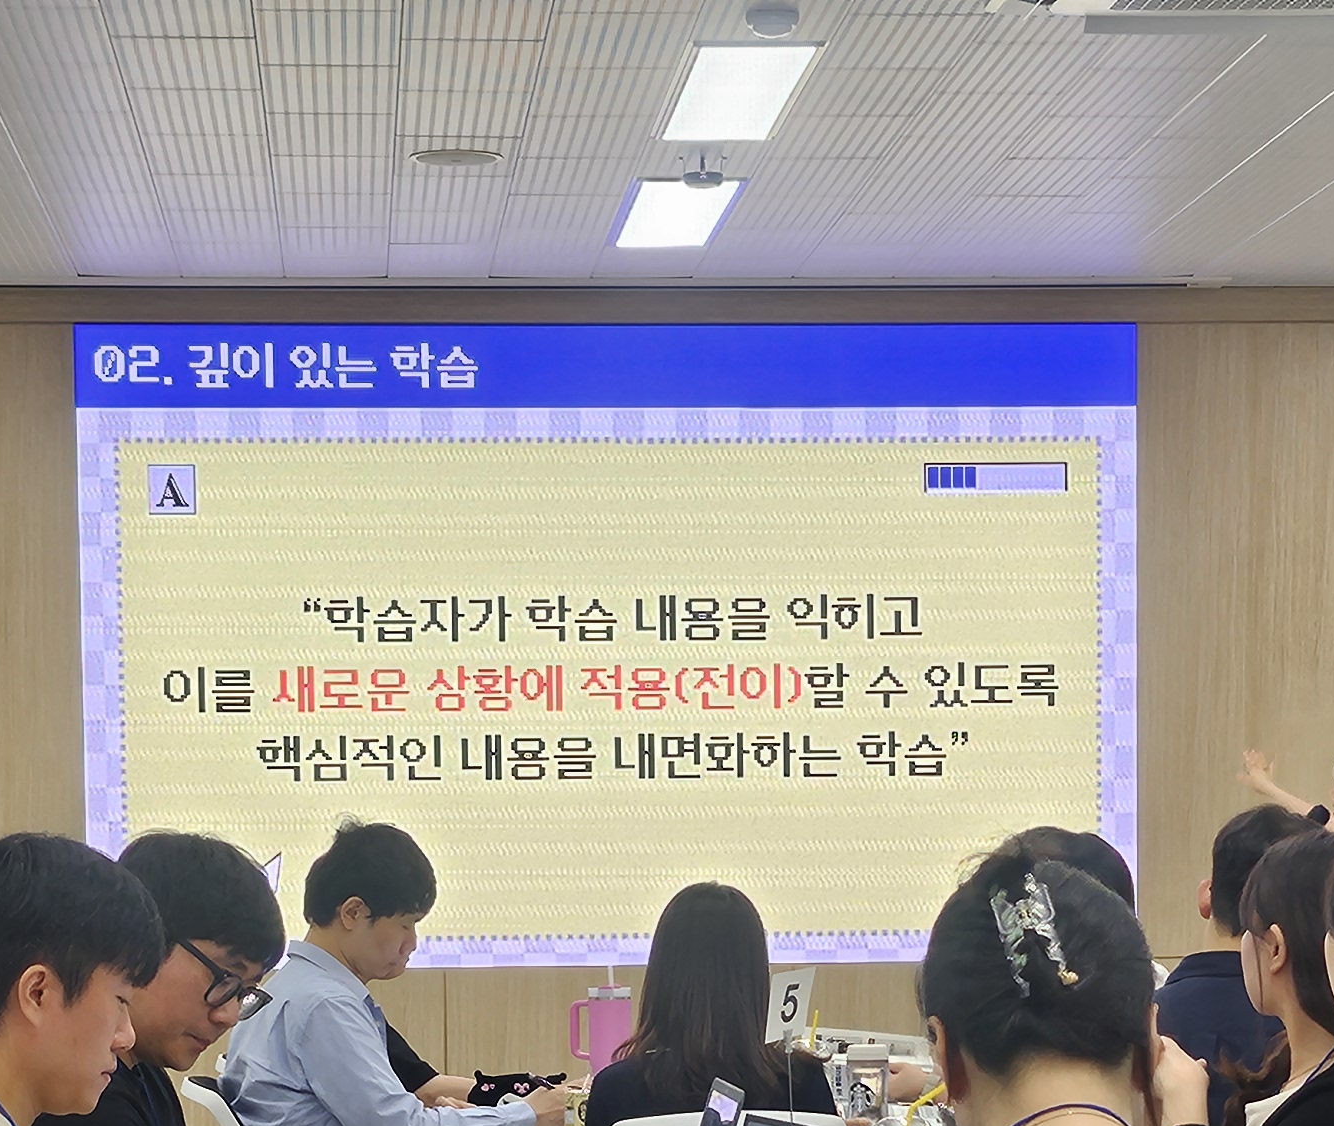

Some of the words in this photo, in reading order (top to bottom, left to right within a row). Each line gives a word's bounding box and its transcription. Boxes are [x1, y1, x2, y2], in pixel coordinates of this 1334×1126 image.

[94, 345, 173, 386] 02.
[188, 342, 274, 388] 깊이
[289, 342, 377, 389] 있는
[390, 342, 479, 388] 학습
[155, 472, 190, 509] A
[303, 595, 512, 643] “학습자가
[525, 595, 617, 642] 학습
[635, 594, 770, 642] 내용을
[786, 593, 923, 640] 익히고
[163, 666, 255, 713] 이를
[272, 665, 410, 713] 새로운
[426, 664, 563, 712] 상황에
[579, 661, 850, 711] 적용(전이)할
[865, 665, 908, 709] 수
[924, 661, 1059, 708] 있도록
[256, 734, 442, 783] 핵심적인
[460, 734, 597, 781] 내용을
[614, 731, 842, 780] 내면화하는
[856, 730, 969, 777] 학습”
[780, 983, 801, 1023] 5
